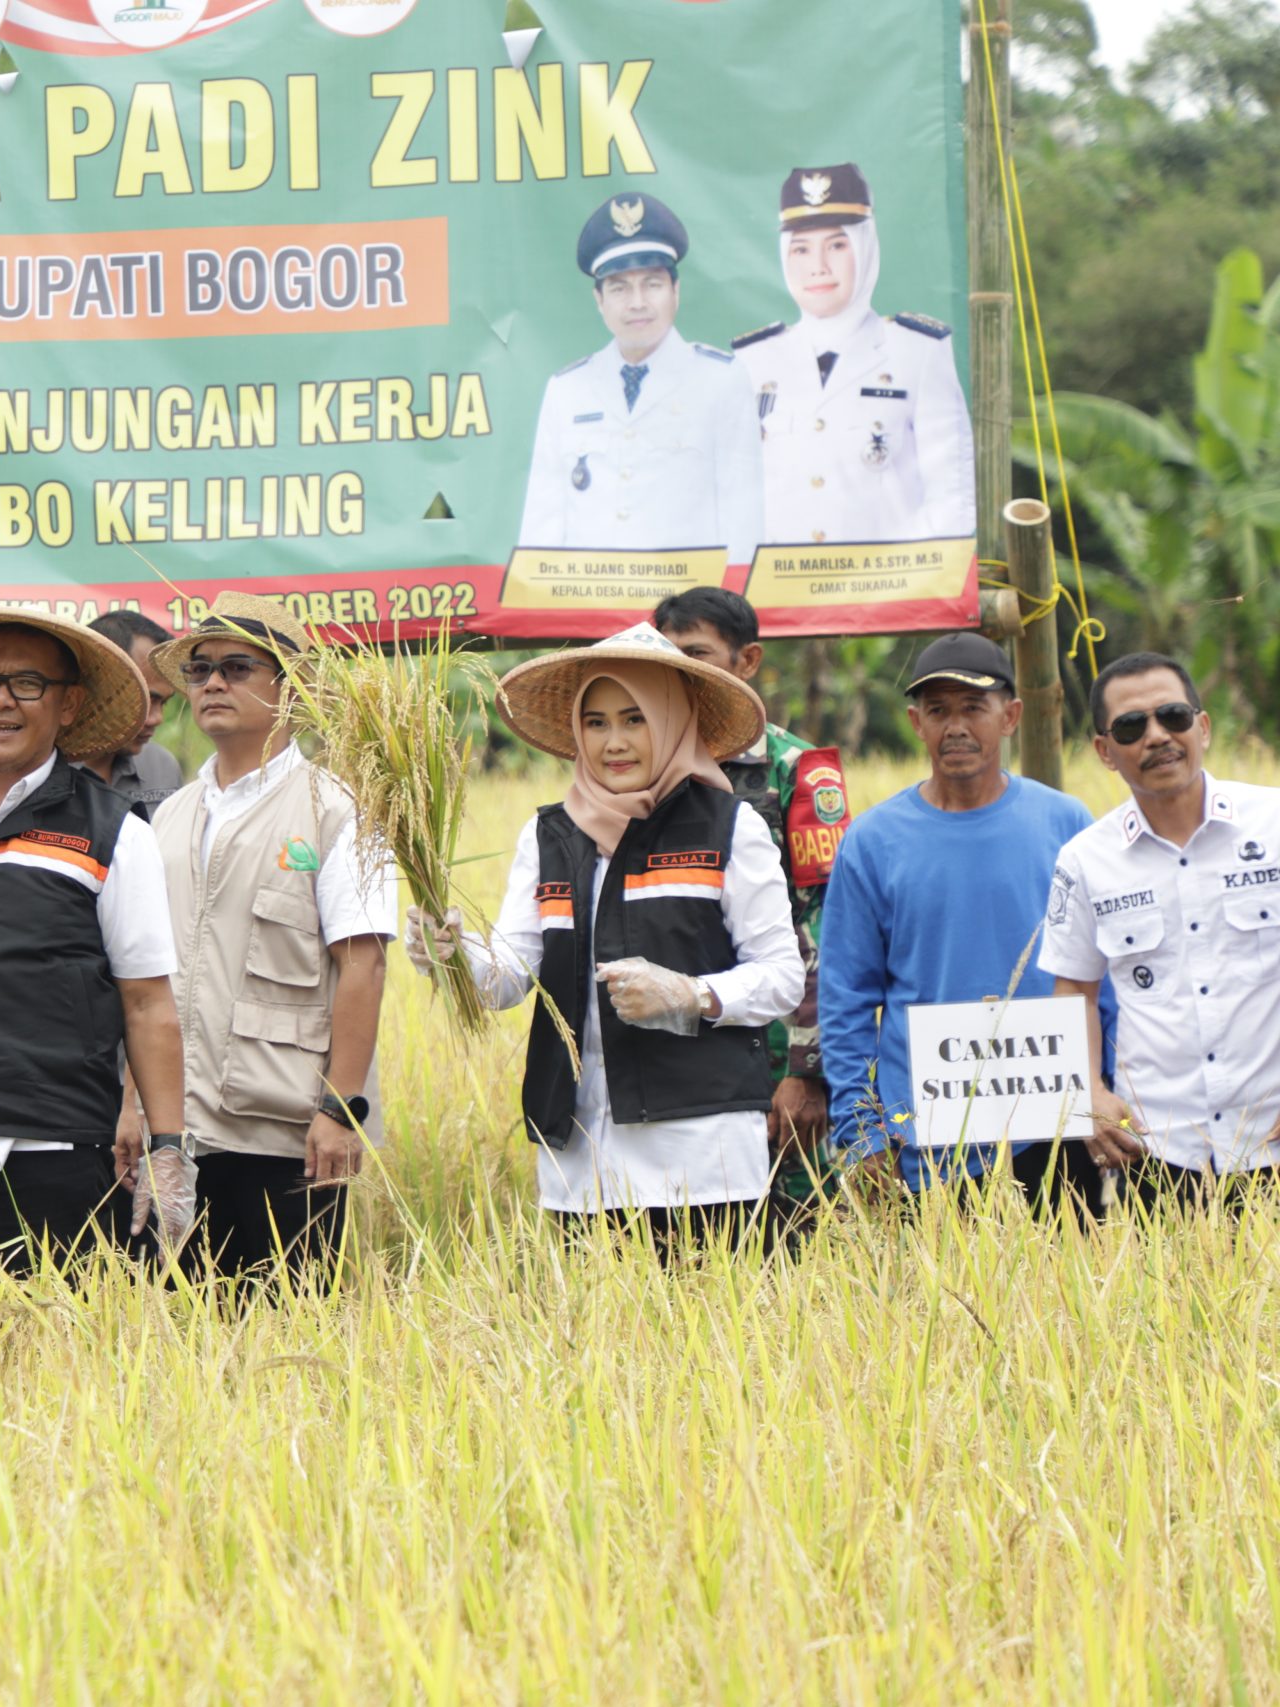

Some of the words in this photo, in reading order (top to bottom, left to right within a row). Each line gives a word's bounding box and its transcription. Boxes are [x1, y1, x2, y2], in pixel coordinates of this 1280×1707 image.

[45, 74, 320, 200] PADI
[370, 59, 658, 188] ZINK
[184, 243, 407, 315] BOGOR
[298, 373, 493, 447] KERJA
[94, 470, 365, 546] KELILING
[539, 562, 563, 574] Drs.
[567, 562, 580, 574] H.
[585, 563, 625, 575] UJANG
[629, 563, 688, 576] SUPRIADI
[774, 559, 795, 571] RIA
[863, 557, 871, 569] A
[552, 585, 593, 597] KEPALA
[596, 585, 624, 598] DESA
[627, 586, 675, 599] CIBANON
[810, 581, 846, 595] CAMAT
[851, 578, 907, 592] SUKARAJA
[167, 596, 208, 631] 19
[260, 589, 378, 627] TOBER
[387, 582, 478, 621] 2022
[61, 837, 86, 849] BOGOR
[660, 854, 708, 865] CAMAT
[1223, 867, 1280, 888] KADE
[938, 1034, 1064, 1063] CAMAT
[922, 1073, 1085, 1101] SUKARAJA
